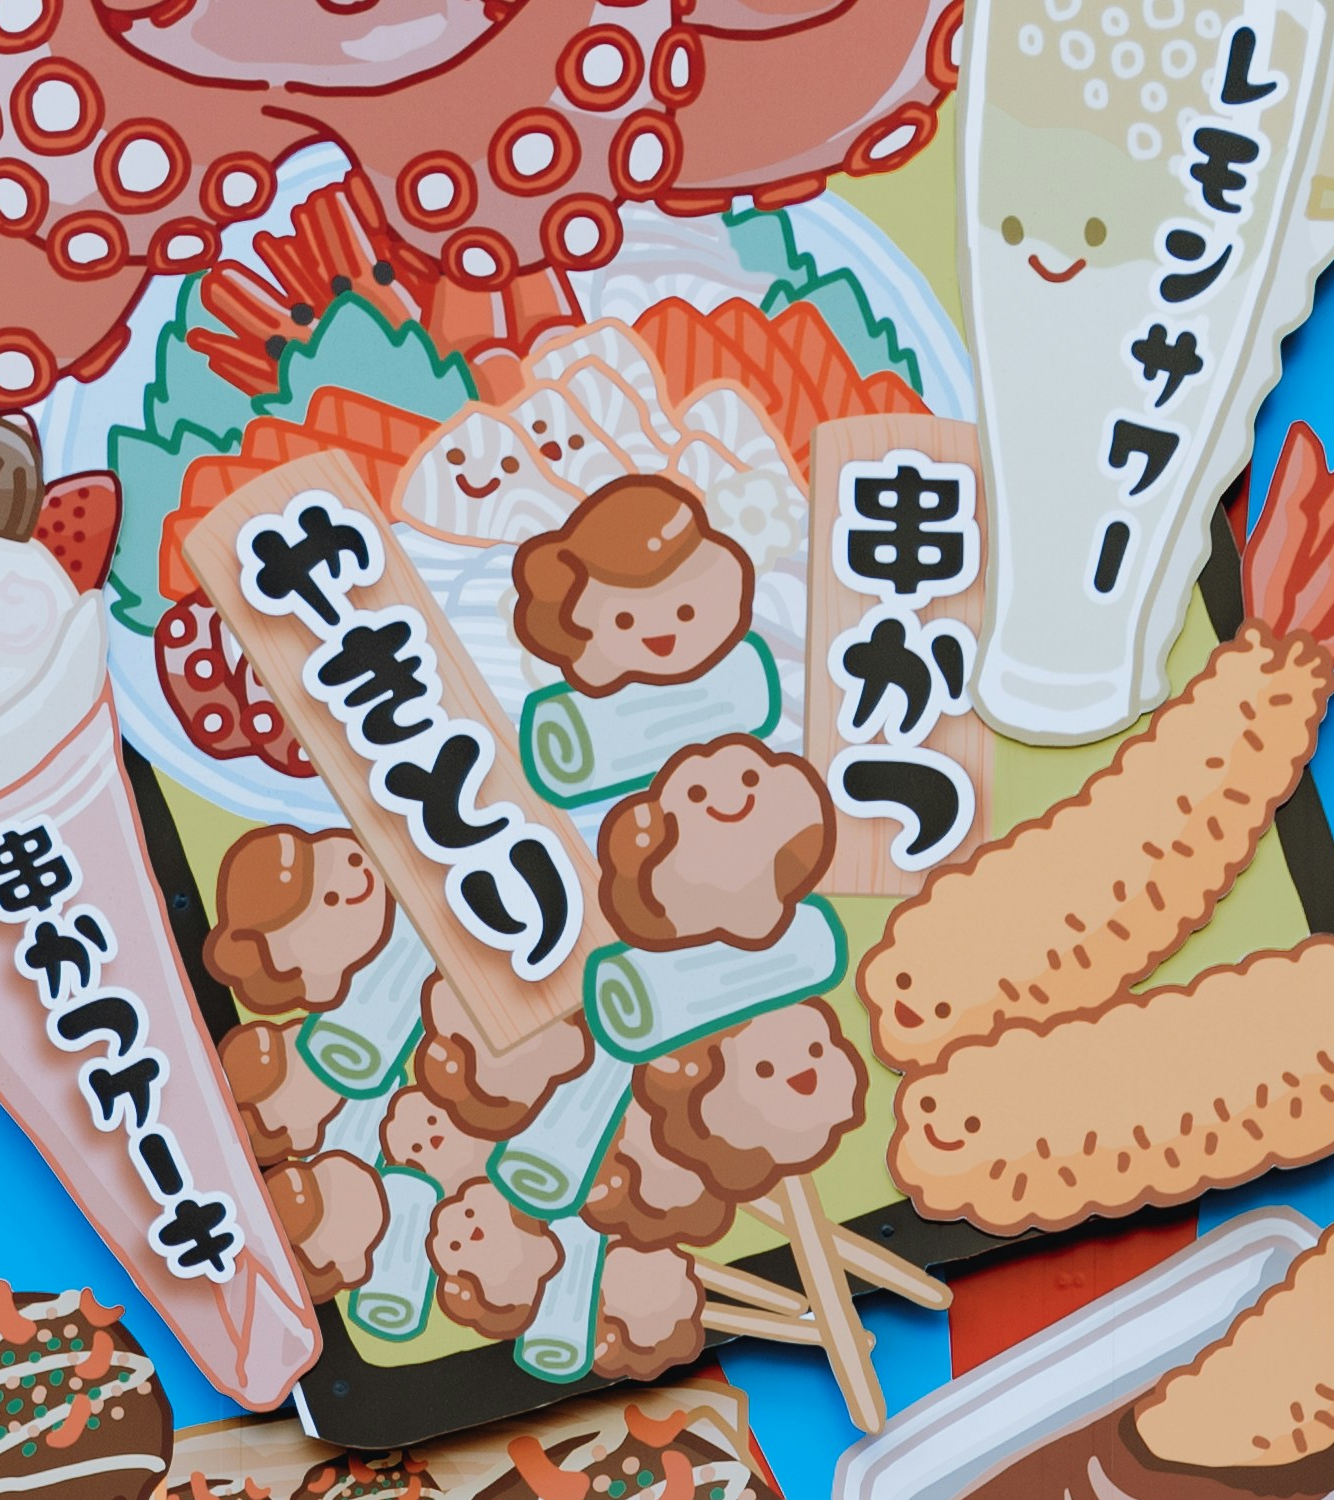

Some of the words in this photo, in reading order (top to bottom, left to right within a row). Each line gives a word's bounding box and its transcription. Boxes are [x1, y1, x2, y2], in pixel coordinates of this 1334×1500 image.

[1093, 25, 1278, 594] レモンサワー
[254, 504, 569, 966] やきとり
[842, 465, 965, 856] 串かつ
